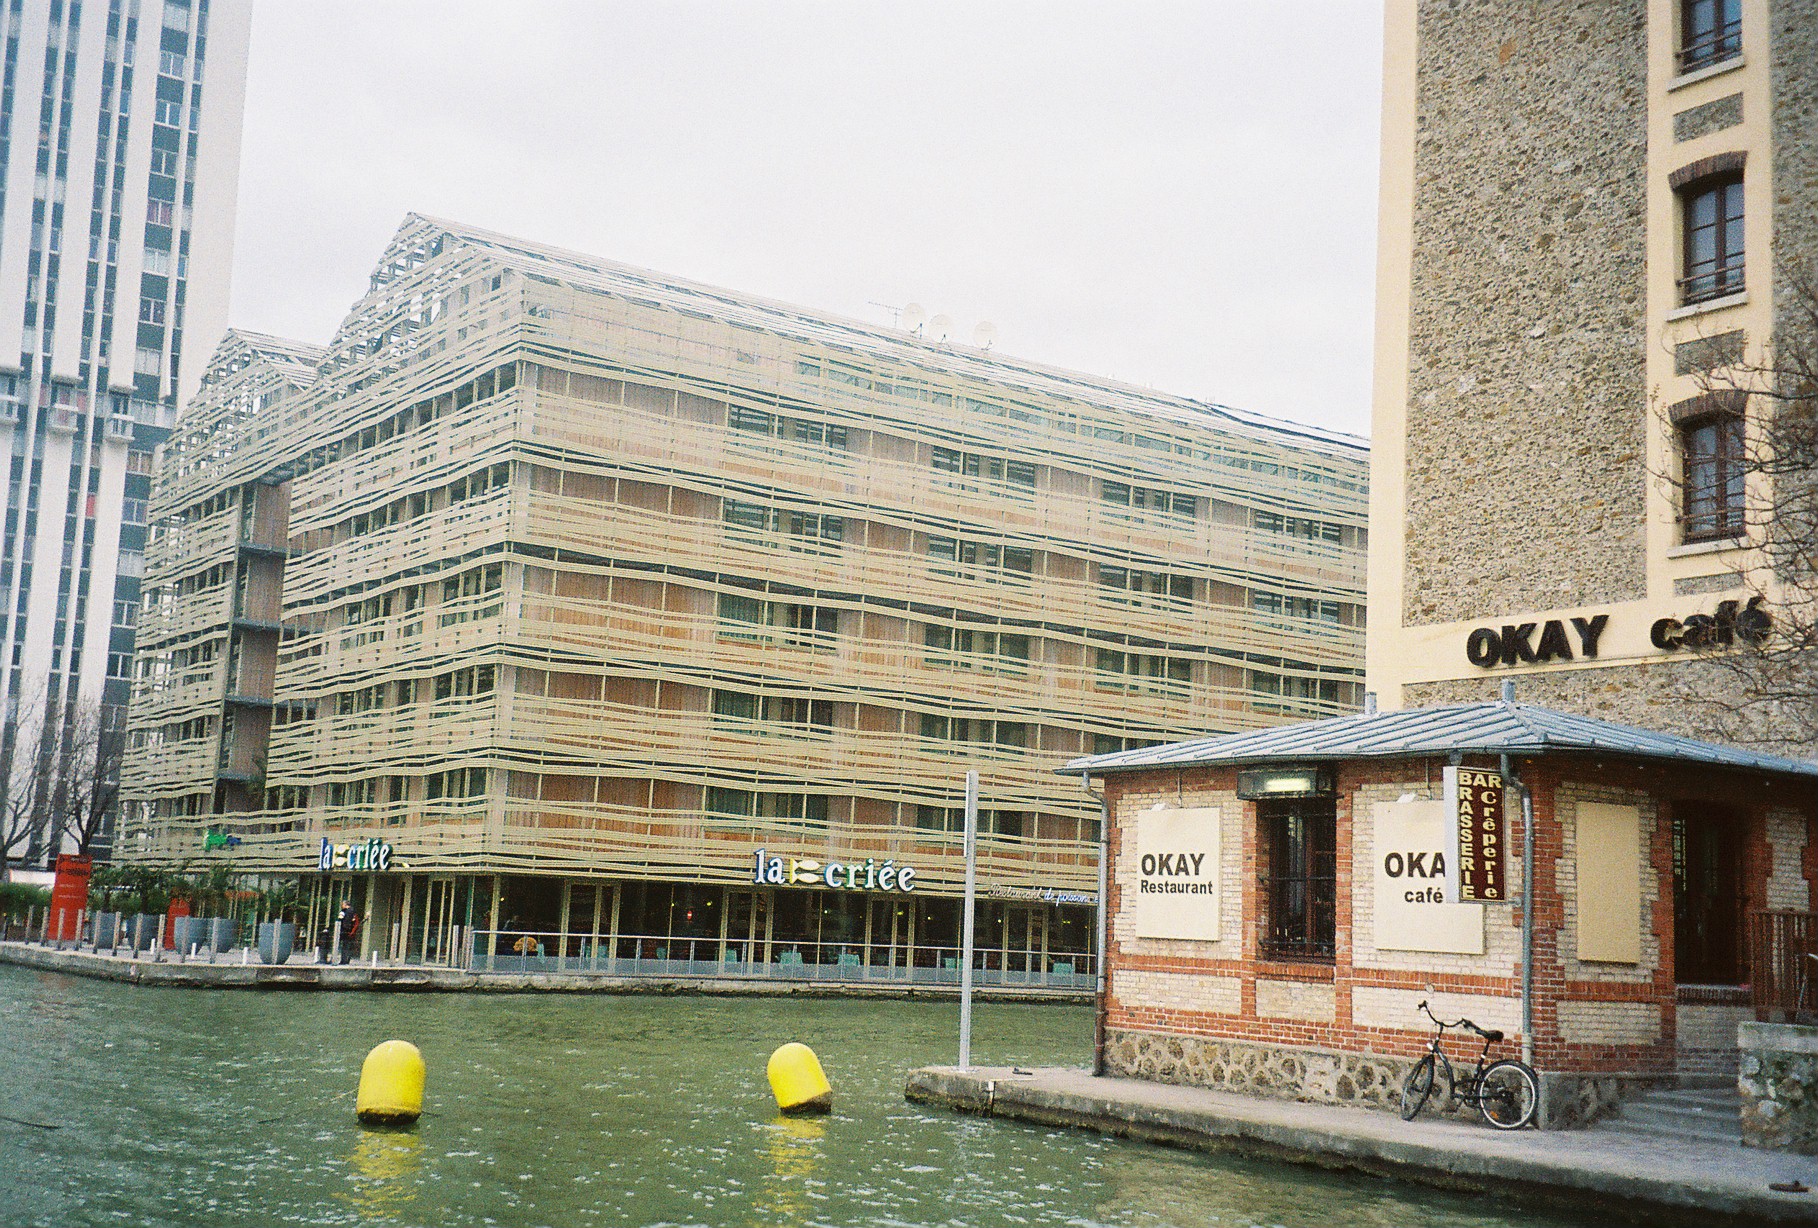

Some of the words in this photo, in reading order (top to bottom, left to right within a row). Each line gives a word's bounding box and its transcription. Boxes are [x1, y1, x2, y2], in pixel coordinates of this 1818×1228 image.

[1466, 614, 1610, 668] OKAY
[1650, 595, 1774, 651] café
[1459, 772, 1502, 788] BAR
[1459, 772, 1475, 899] BRASSERIE
[1480, 791, 1498, 898] Crêperie
[318, 837, 334, 870] la
[347, 837, 392, 871] criée
[1141, 853, 1205, 876] OKAY
[1384, 852, 1446, 878] OKA
[753, 848, 785, 885] la
[823, 857, 918, 892] criée
[1140, 879, 1213, 895] Restaurant
[1404, 887, 1444, 904] café
